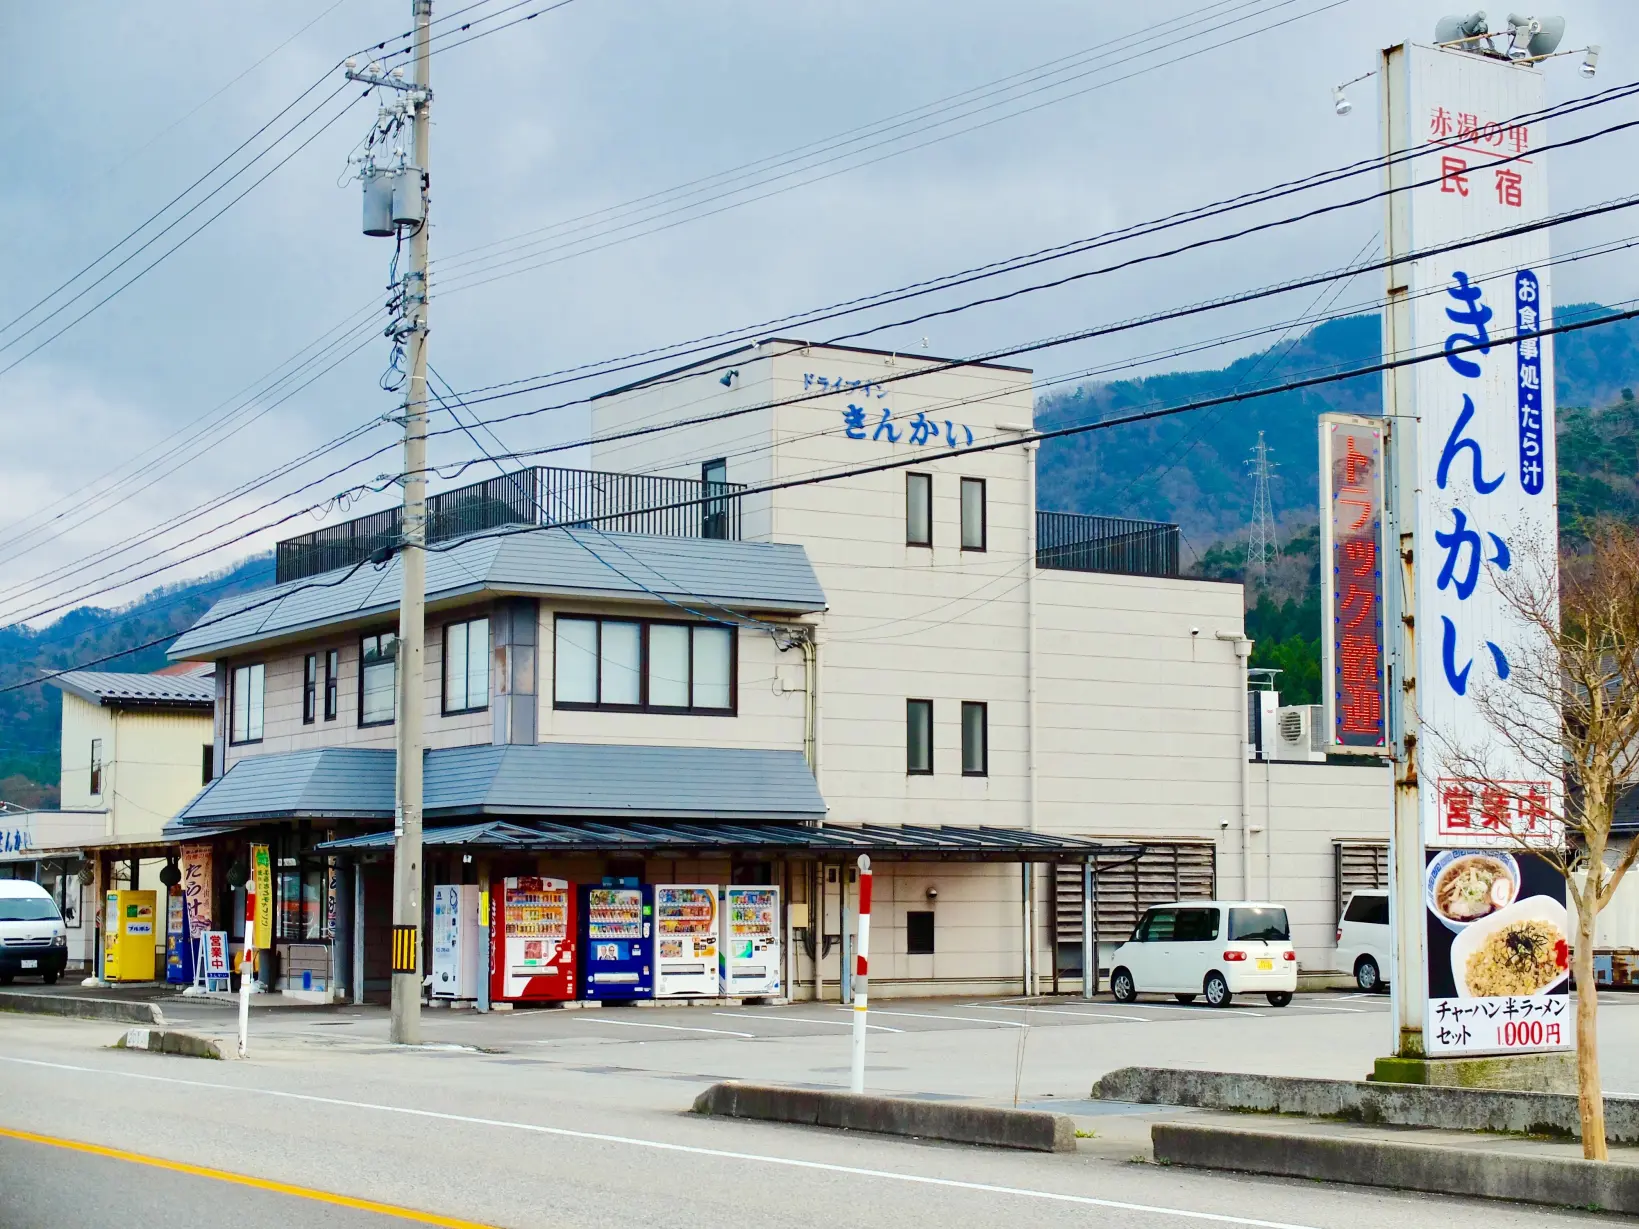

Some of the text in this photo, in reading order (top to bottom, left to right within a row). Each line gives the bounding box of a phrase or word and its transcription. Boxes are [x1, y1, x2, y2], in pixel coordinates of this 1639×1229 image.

[1430, 107, 1529, 155] 赤湯の里
[1441, 156, 1523, 208] 民宿
[842, 403, 974, 448] きんかい
[1436, 271, 1511, 696] きんかい
[1339, 435, 1380, 734] トラック歓迎
[1443, 785, 1547, 830] 営業中
[186, 863, 203, 918] たら汁
[209, 935, 224, 969] 営業中
[1435, 997, 1567, 1023] チャーハン半ラーメン
[1436, 1025, 1472, 1046] セット
